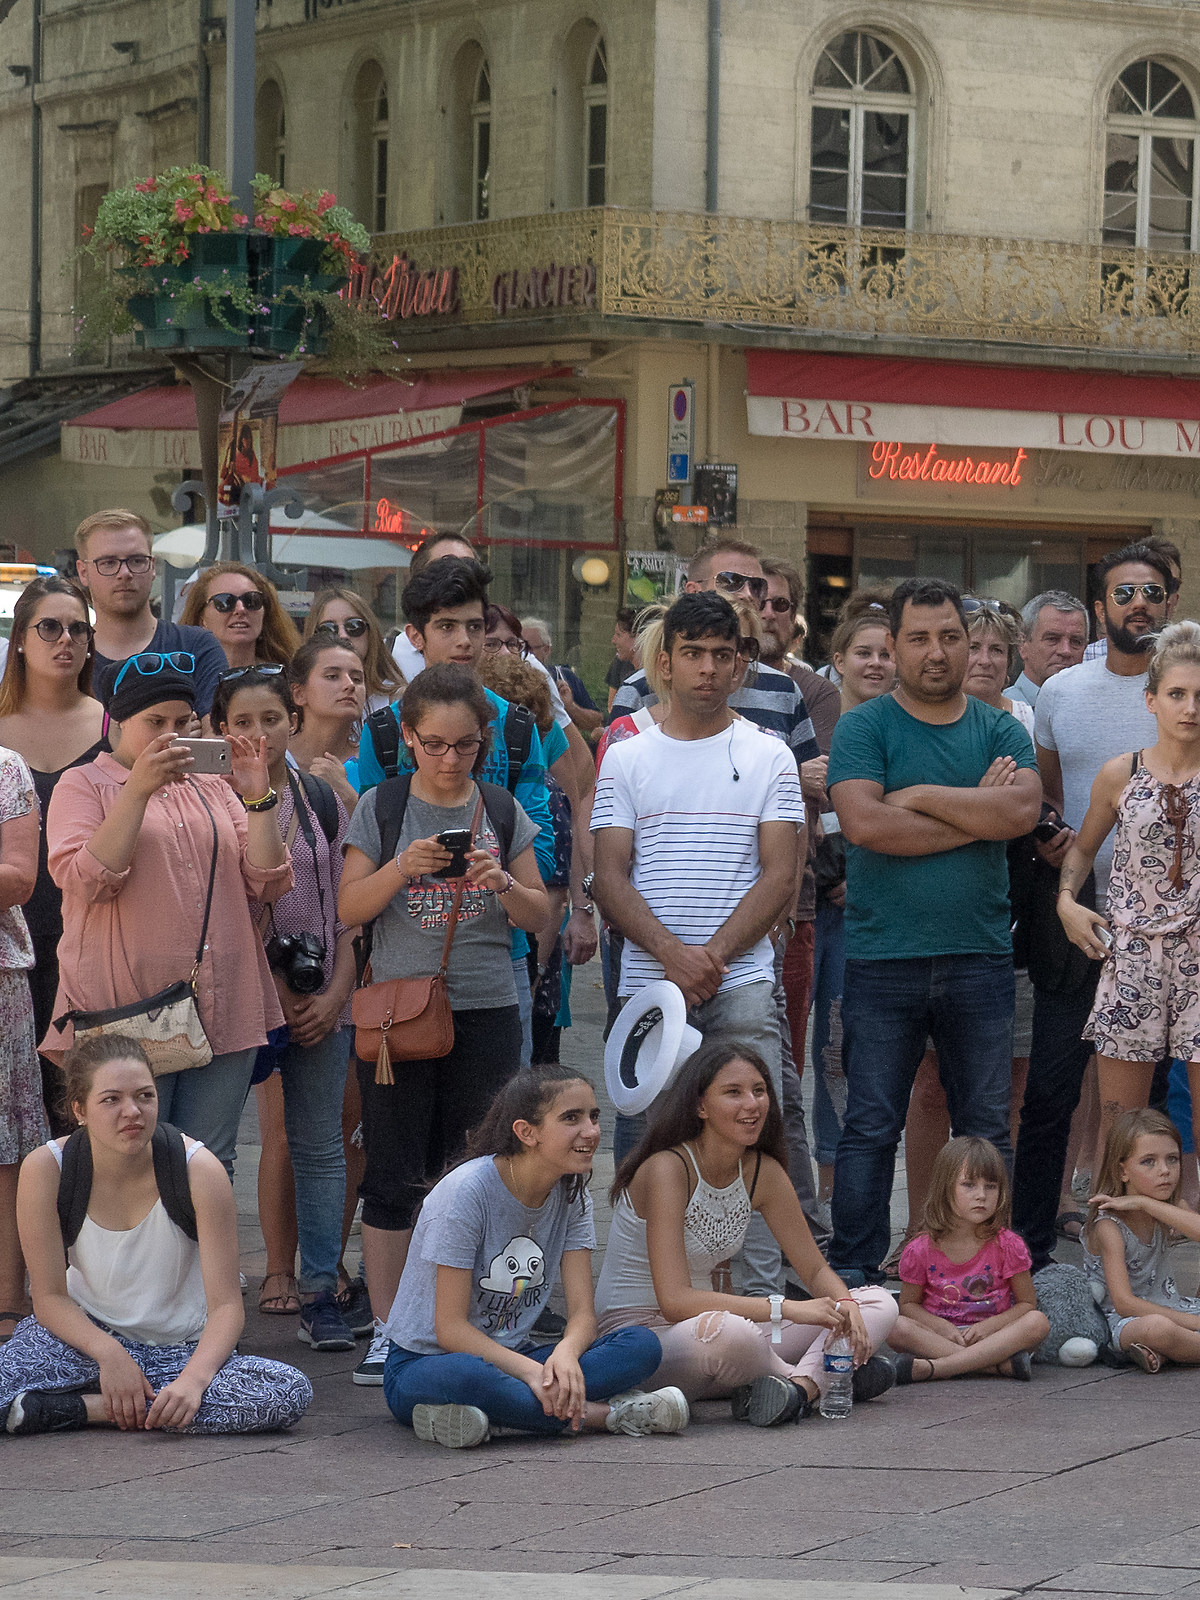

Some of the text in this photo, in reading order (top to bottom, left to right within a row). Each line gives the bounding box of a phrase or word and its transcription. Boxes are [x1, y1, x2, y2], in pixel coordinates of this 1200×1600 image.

[493, 261, 597, 315] GLACIER
[329, 415, 441, 457] RESTAURANT
[780, 400, 875, 437] BAR
[1056, 414, 1146, 450] LOU
[79, 432, 192, 465] BAR LOU
[868, 440, 1028, 486] Restaurant
